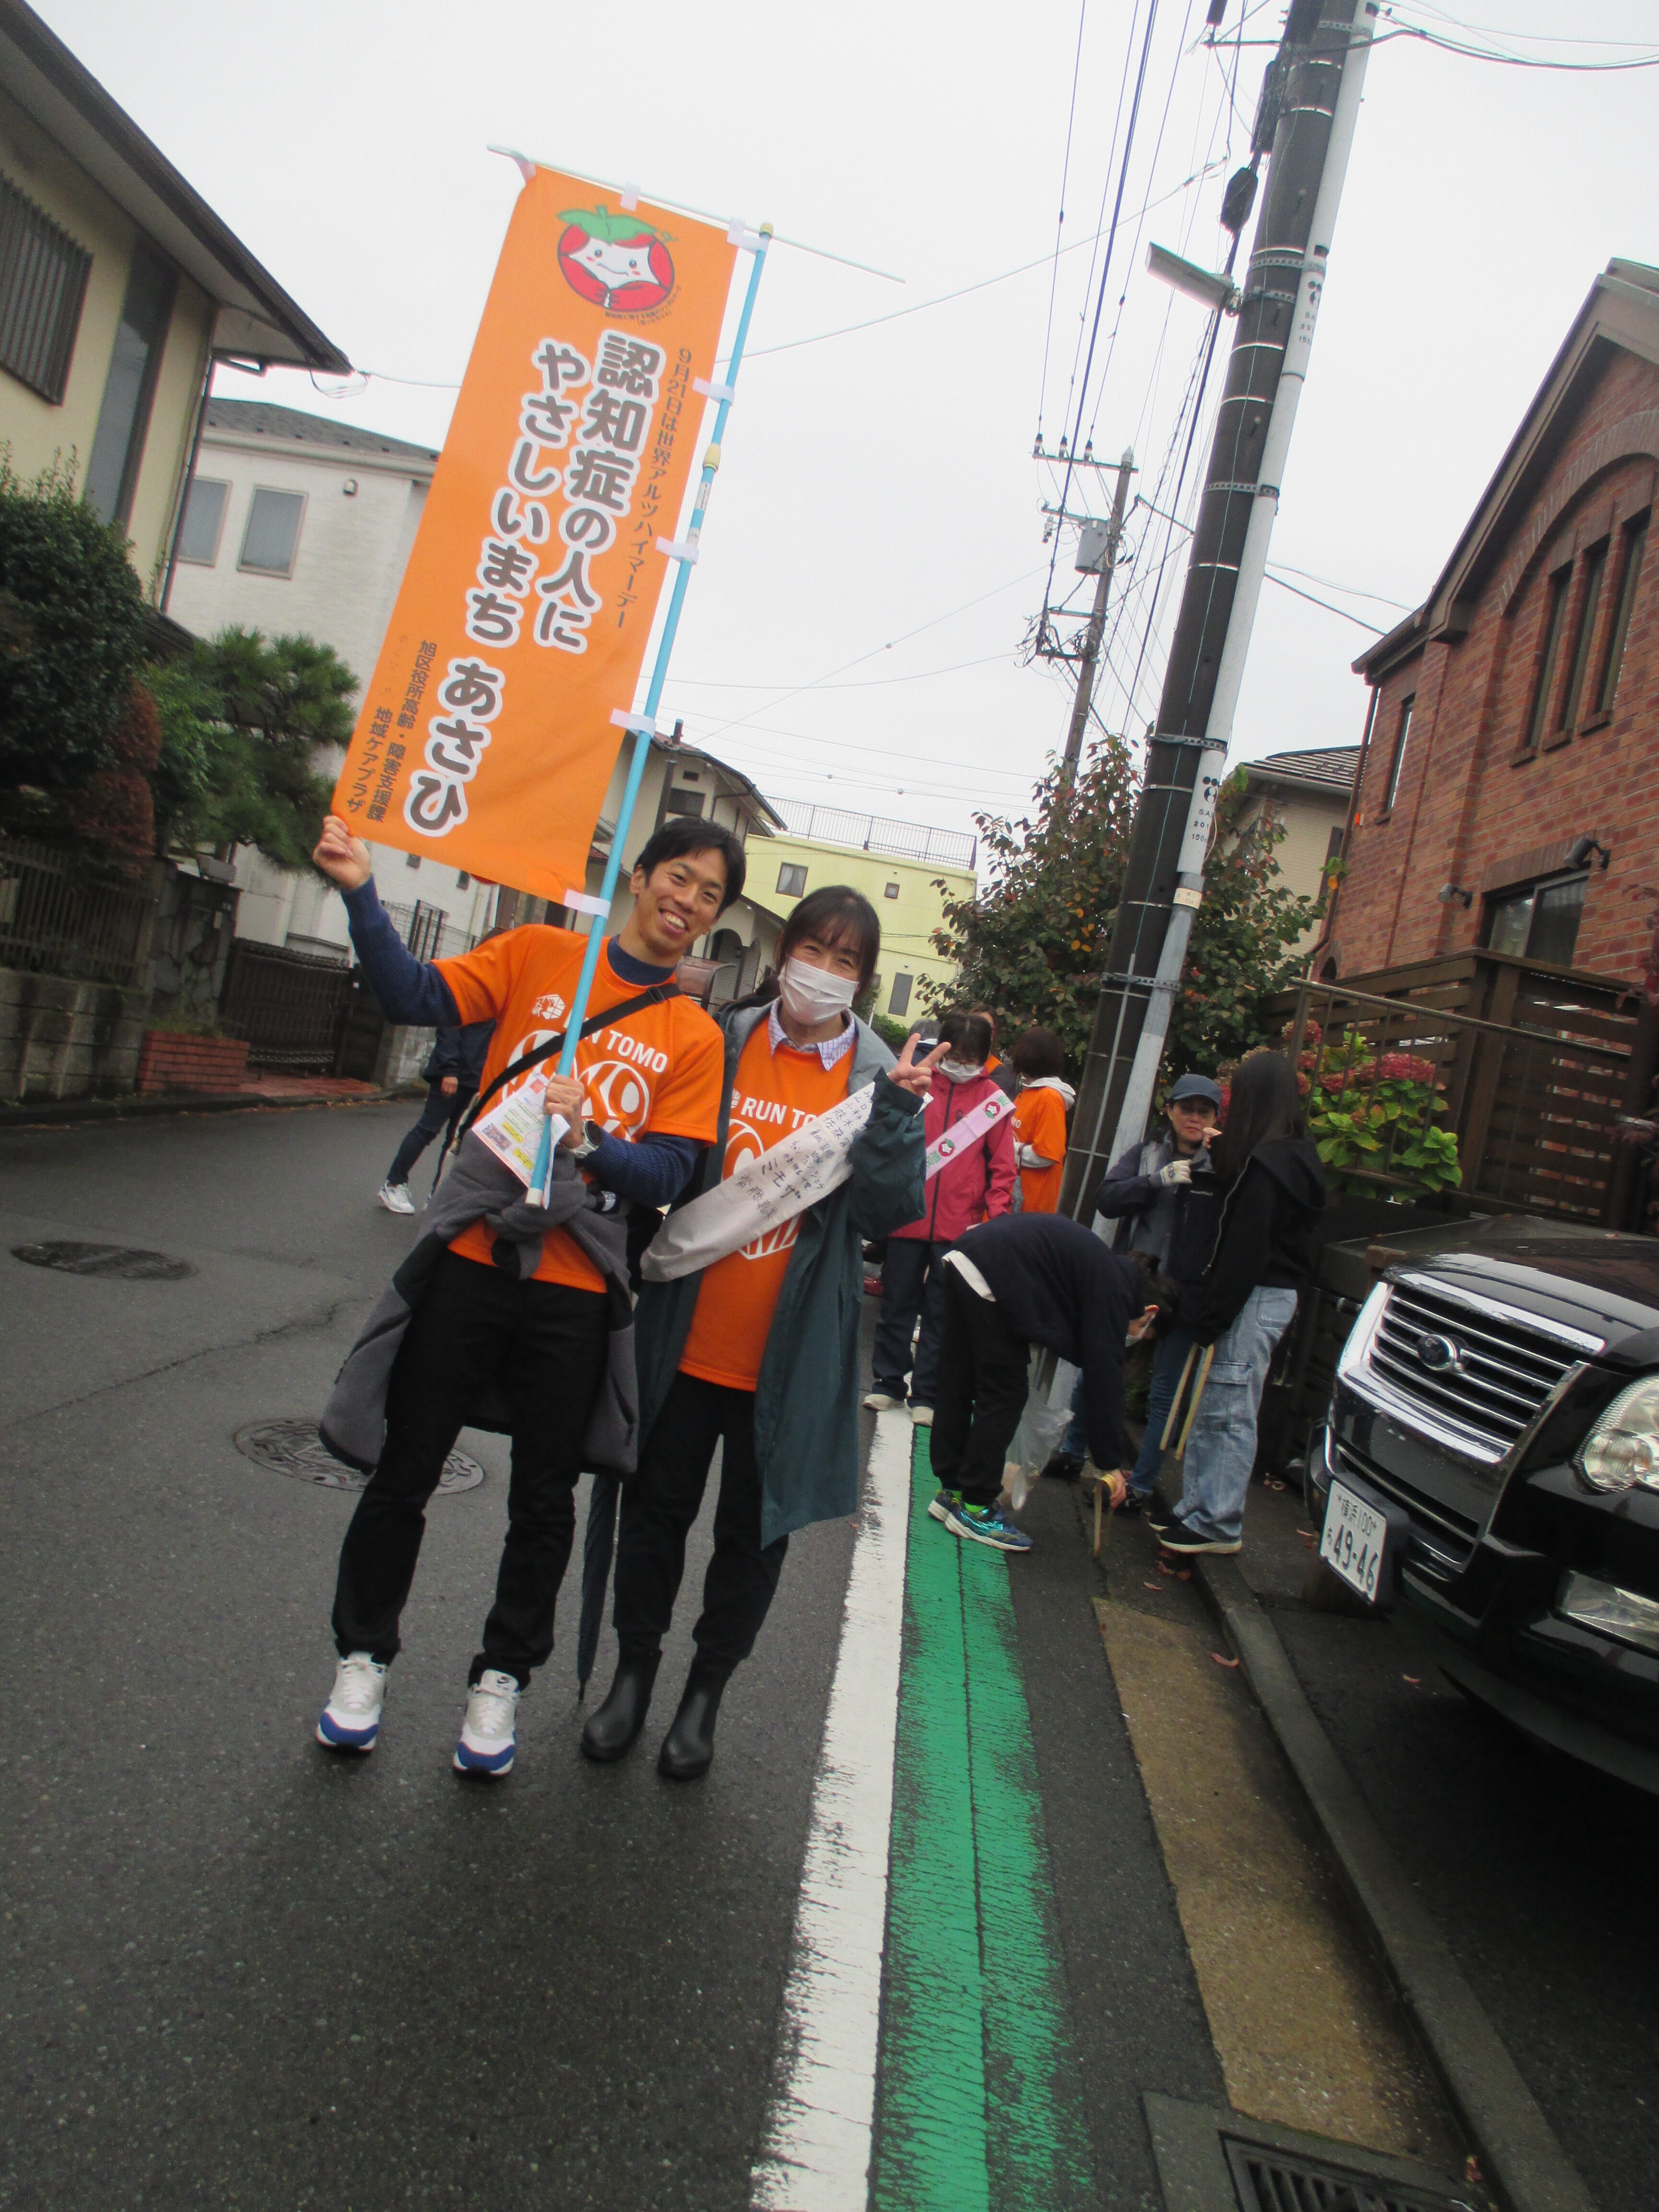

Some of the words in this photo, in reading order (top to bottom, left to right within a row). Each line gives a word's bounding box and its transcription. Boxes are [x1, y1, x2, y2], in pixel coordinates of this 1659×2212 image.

[471, 342, 586, 642] やさしいまち
[538, 334, 661, 648] 認知症の人に
[347, 706, 394, 813] 地域ケアプラザ
[366, 639, 437, 823] 旭区役所高齢・障害支援課
[409, 662, 500, 832] あさひ
[607, 1029, 668, 1073] TOMO
[741, 1096, 787, 1125] RUN
[761, 1157, 801, 1199] ミモザ
[1334, 1523, 1379, 1592] 49-46
